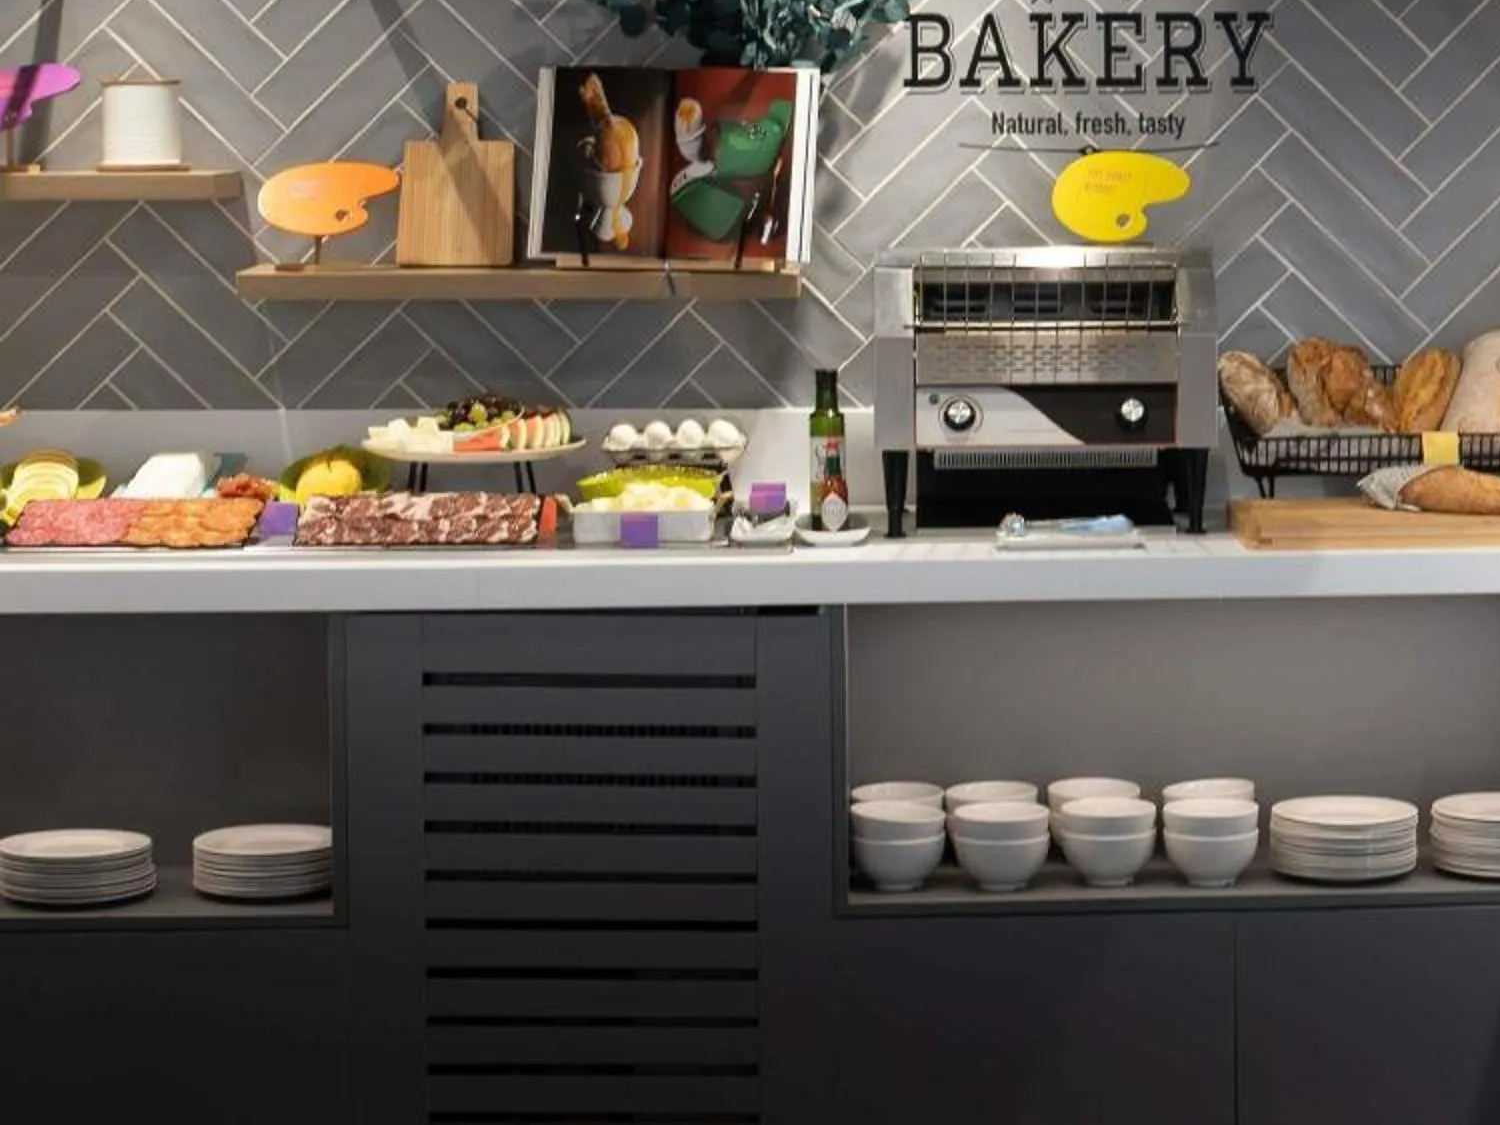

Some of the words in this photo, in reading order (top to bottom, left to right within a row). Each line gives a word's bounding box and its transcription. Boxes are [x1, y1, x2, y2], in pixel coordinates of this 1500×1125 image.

[903, 12, 1274, 93] BAKERY
[991, 112, 1069, 138] Natural,
[1075, 111, 1132, 138] fresh,
[1139, 112, 1186, 139] tasty
